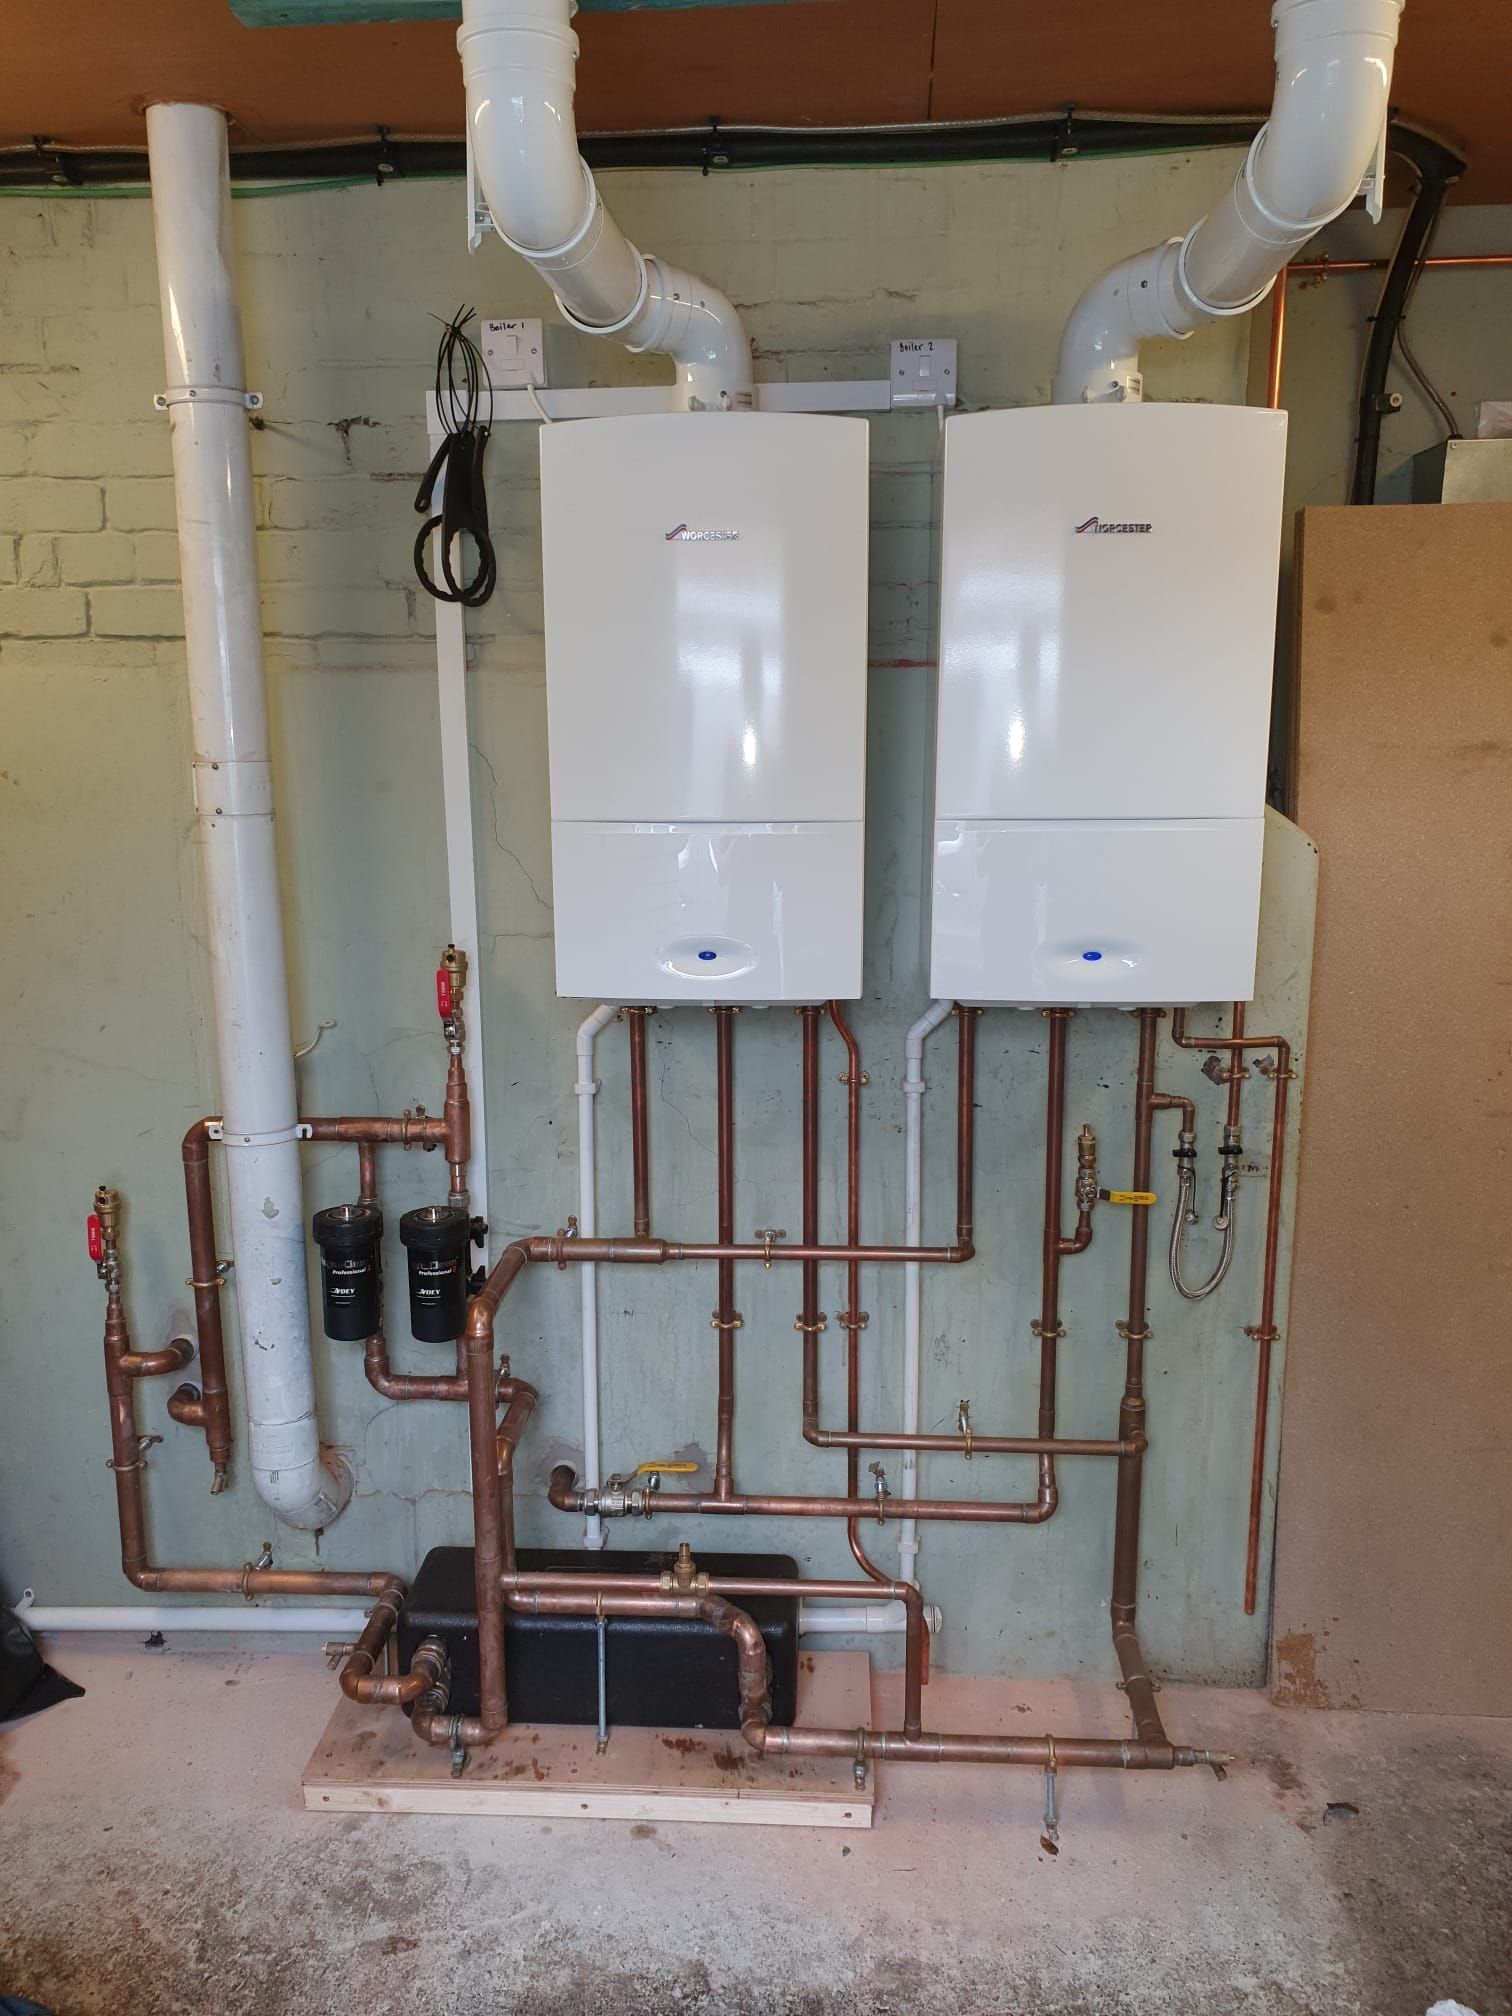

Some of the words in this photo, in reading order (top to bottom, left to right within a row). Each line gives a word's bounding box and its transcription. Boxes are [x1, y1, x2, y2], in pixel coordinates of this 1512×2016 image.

[489, 322, 518, 332] Boiler
[521, 321, 525, 329] 1
[899, 341, 924, 352] Boiler
[928, 341, 934, 351] 2
[332, 1266, 367, 1275] Professional
[418, 1267, 453, 1276] Professional
